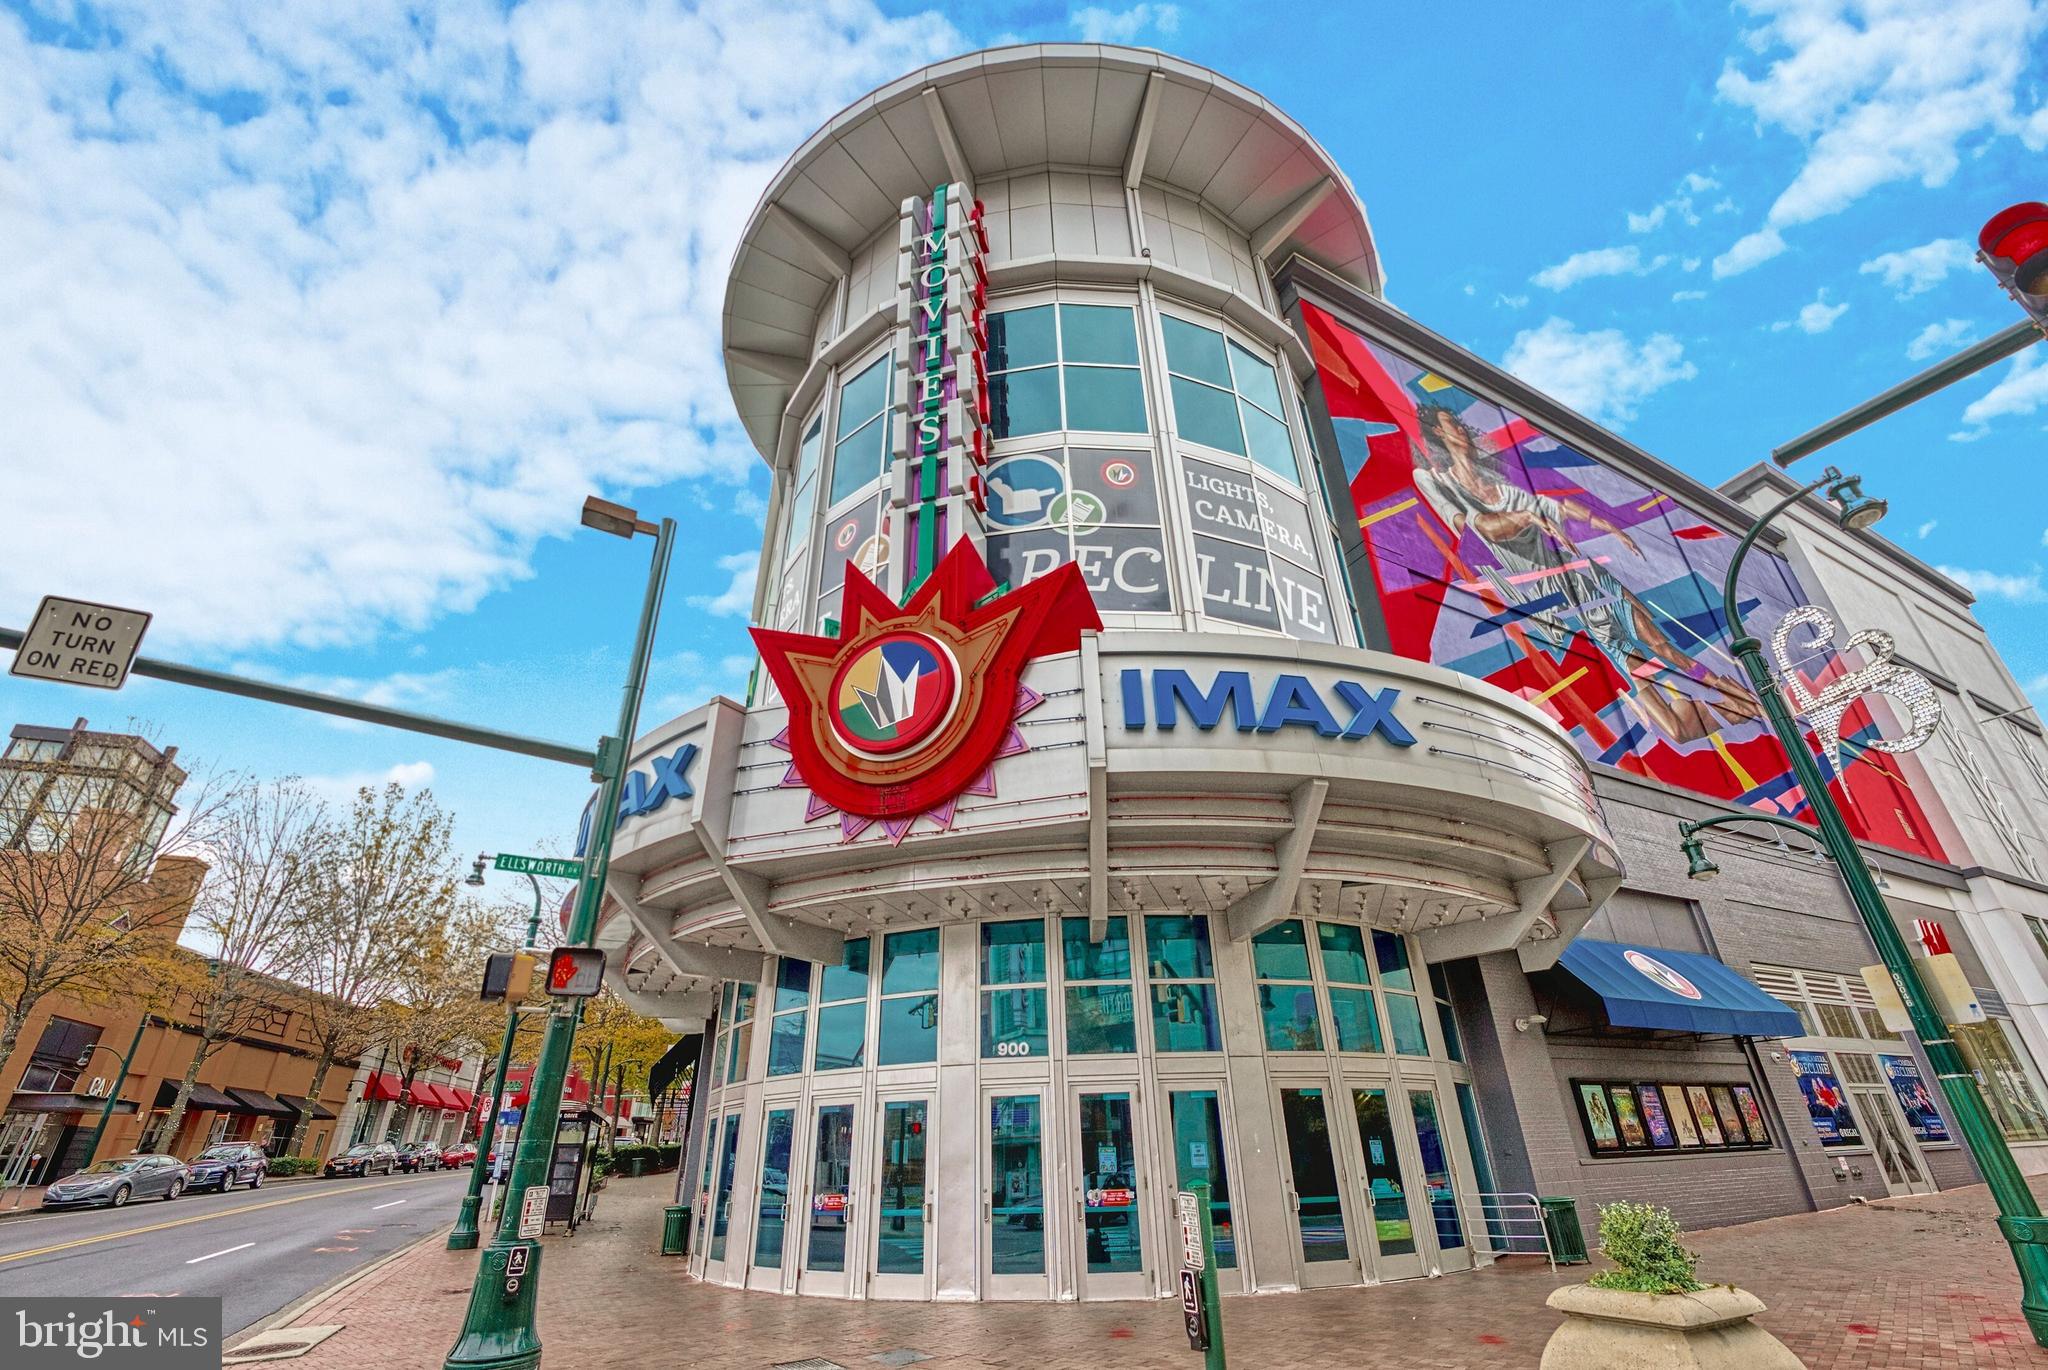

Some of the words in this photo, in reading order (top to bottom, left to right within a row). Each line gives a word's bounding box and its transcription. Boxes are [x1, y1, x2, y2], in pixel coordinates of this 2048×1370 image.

[918, 229, 950, 446] MOVIES
[1195, 500, 1314, 562] CAMERA,
[71, 611, 112, 631] NO
[52, 630, 116, 655] TURN
[27, 650, 61, 669] ON
[70, 657, 118, 679] RED
[1121, 668, 1418, 747] IMAX
[500, 856, 565, 875] ELLSWORTH
[997, 1041, 1030, 1056] 900
